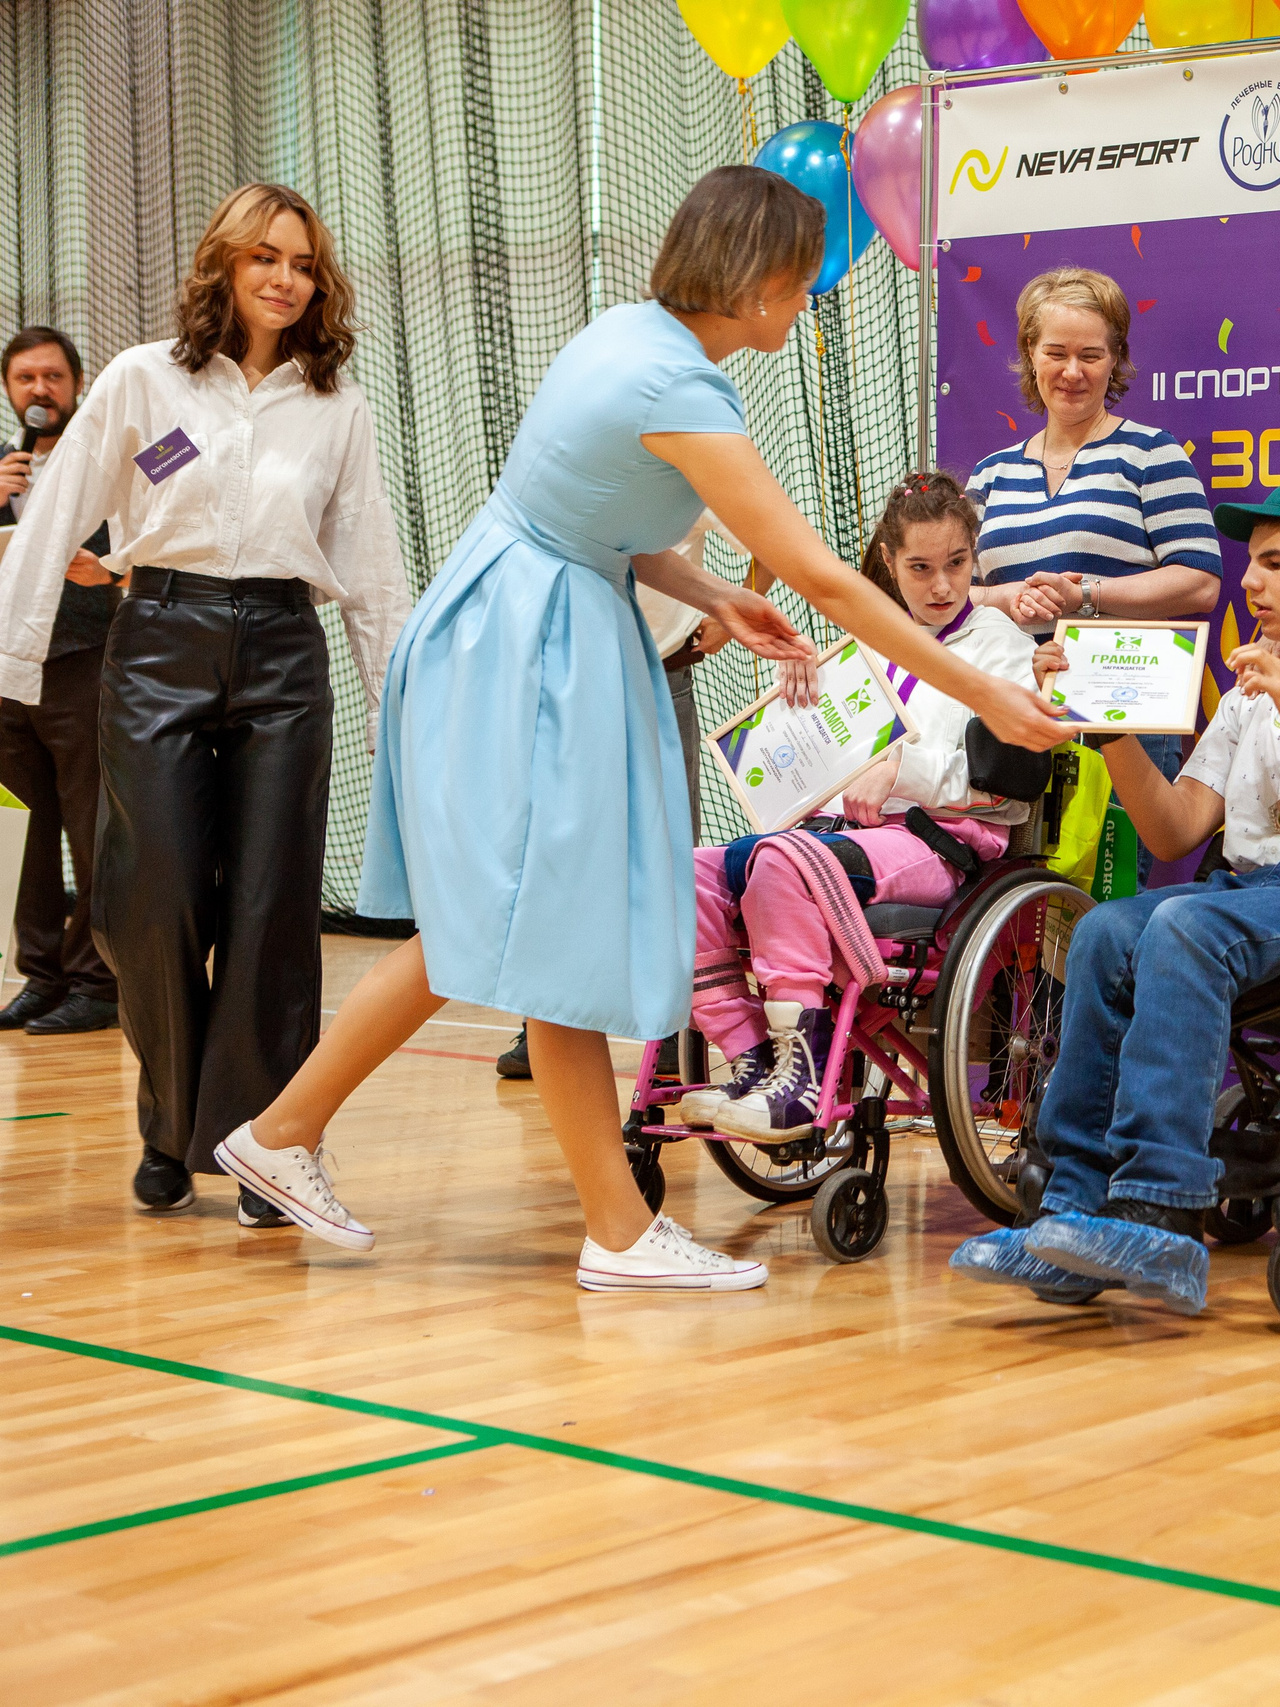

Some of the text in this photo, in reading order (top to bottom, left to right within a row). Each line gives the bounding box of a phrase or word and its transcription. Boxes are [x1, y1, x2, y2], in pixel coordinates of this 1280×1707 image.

[1230, 80, 1273, 111] ЛЕЧЕБНЫЕ
[1015, 136, 1200, 178] NEVA SPORT
[150, 445, 191, 475] Организатор
[1092, 655, 1159, 665] ГРАМОТА
[818, 692, 852, 748] ГРАМОТА
